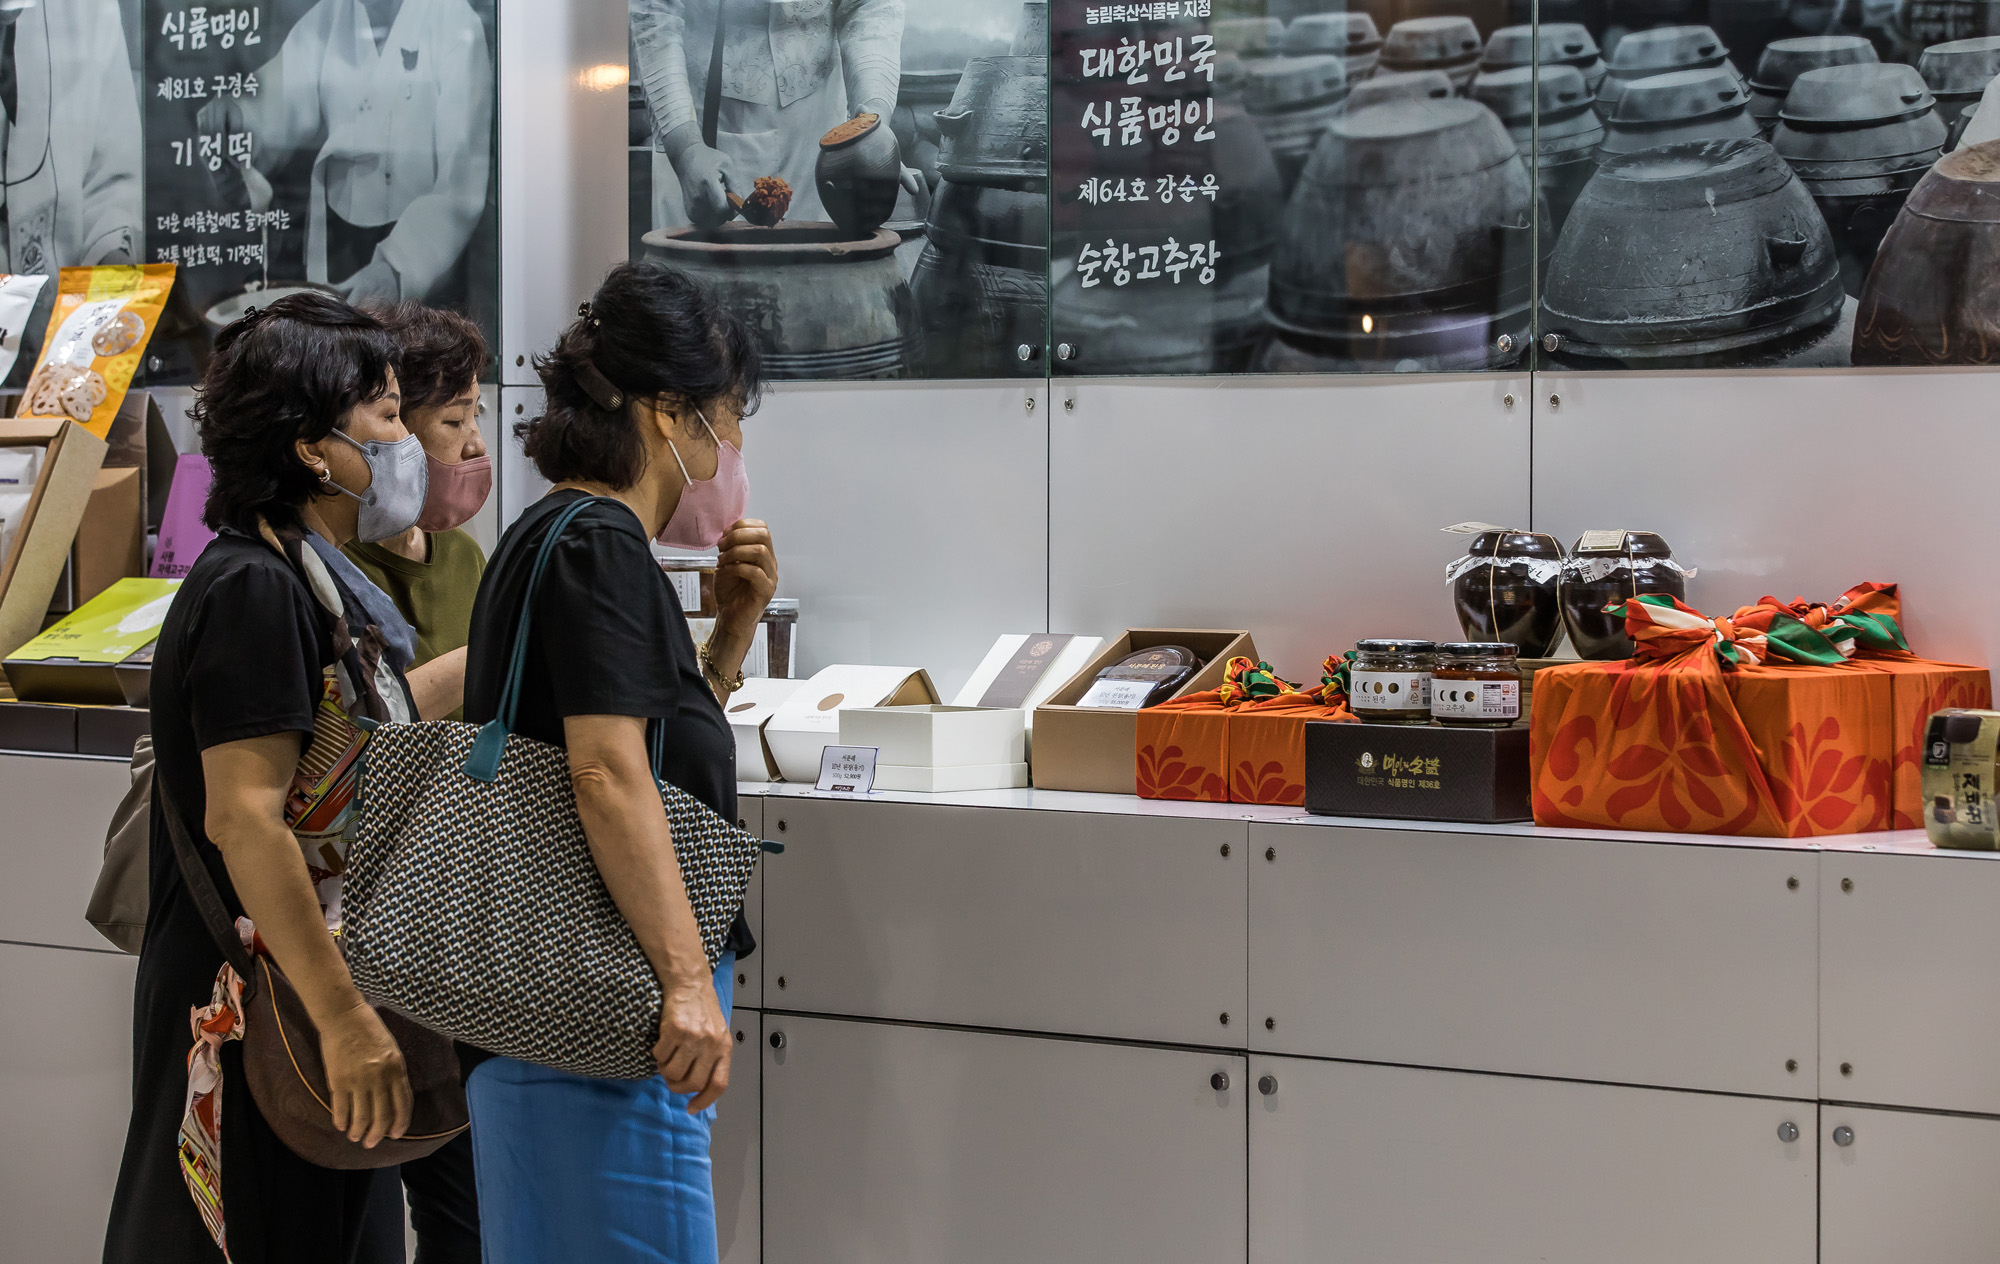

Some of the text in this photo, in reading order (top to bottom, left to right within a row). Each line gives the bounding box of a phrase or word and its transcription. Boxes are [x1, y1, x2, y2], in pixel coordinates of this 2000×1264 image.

[1086, 0, 1211, 25] 농림축산식품부 지정
[161, 6, 261, 51] 식품명인
[1079, 34, 1217, 85] 대한민국
[157, 72, 259, 101] 제81호 구경숙
[1081, 96, 1216, 146] 식품명인
[171, 132, 253, 170] 기정떡
[1077, 173, 1220, 206] 제64호 강순옥
[157, 209, 290, 234] 더운 여름철에도 즐겨먹는
[227, 244, 264, 265] 기정떡
[1077, 236, 1221, 289] 순창고추장
[1445, 704, 1465, 712] 고추장
[1357, 776, 1384, 787] 대한민국
[1388, 778, 1415, 788] 식품명인
